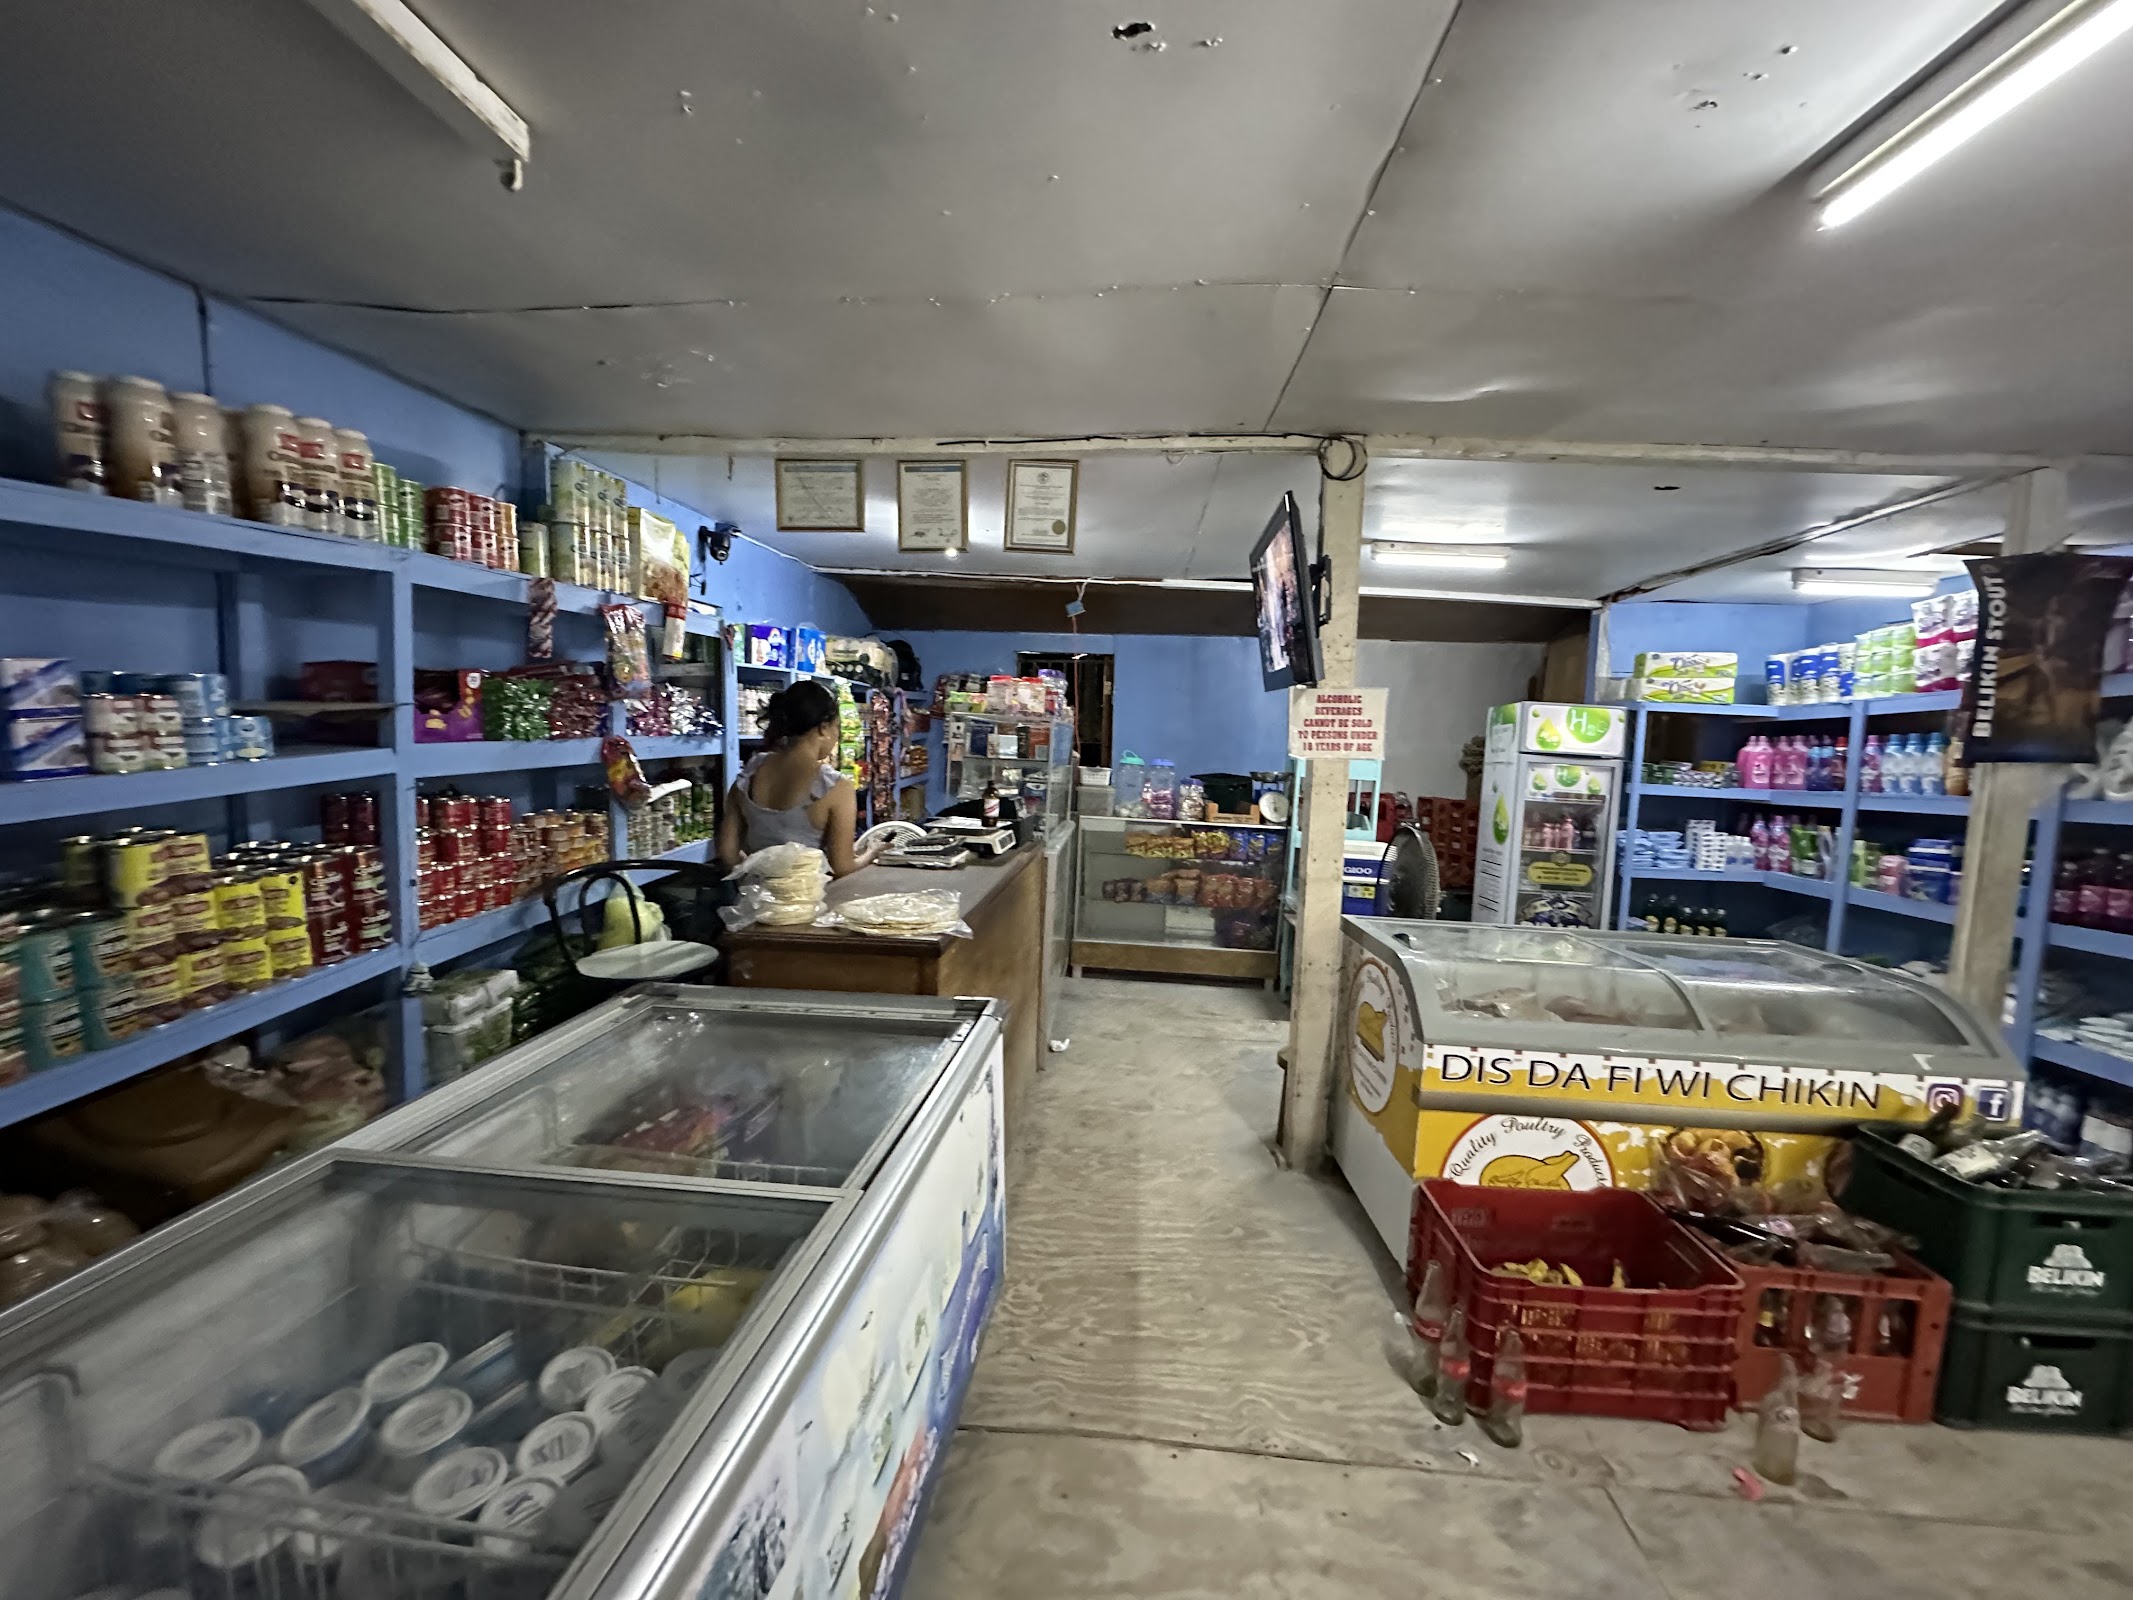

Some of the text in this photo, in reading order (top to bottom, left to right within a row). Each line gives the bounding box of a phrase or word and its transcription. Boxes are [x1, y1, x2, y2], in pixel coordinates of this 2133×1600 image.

[1972, 575, 2007, 738] BELIKIN STOUT
[1317, 695, 1362, 703] ALCOHOLIC
[1315, 707, 1362, 715] BEVERAGES
[1303, 719, 1372, 728] CANNOT BE SOLD
[1297, 730, 1377, 739] TO PERSONS UNDER
[1303, 742, 1372, 751] 18 YEARS OF AGE
[1440, 1053, 1882, 1111] DIS DA FI WI CHIKIN
[1450, 1131, 1497, 1177] Quality
[1501, 1116, 1567, 1140] Poultry
